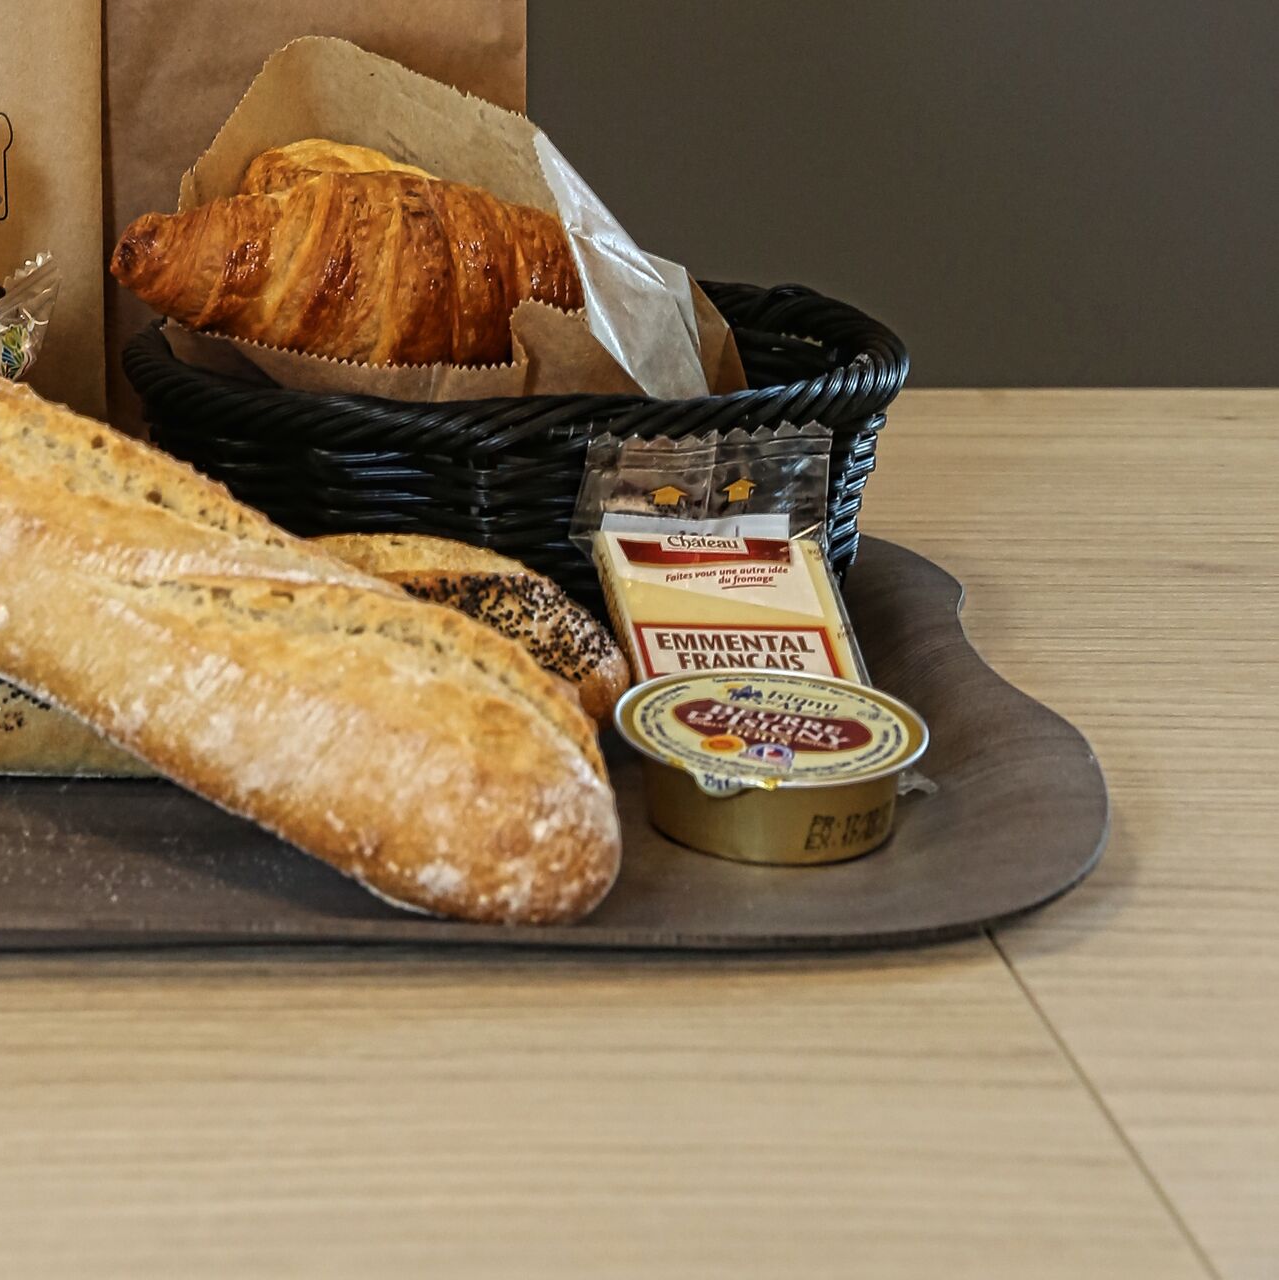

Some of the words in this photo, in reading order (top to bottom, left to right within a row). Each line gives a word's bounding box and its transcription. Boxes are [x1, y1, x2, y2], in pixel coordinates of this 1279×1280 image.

[665, 573, 693, 582] Faites
[695, 570, 717, 579] vous
[719, 568, 738, 576] une
[739, 566, 766, 575] autre
[768, 565, 789, 574] idée
[718, 575, 732, 584] du
[732, 575, 775, 586] fromage
[655, 632, 816, 654] EMMENTAL
